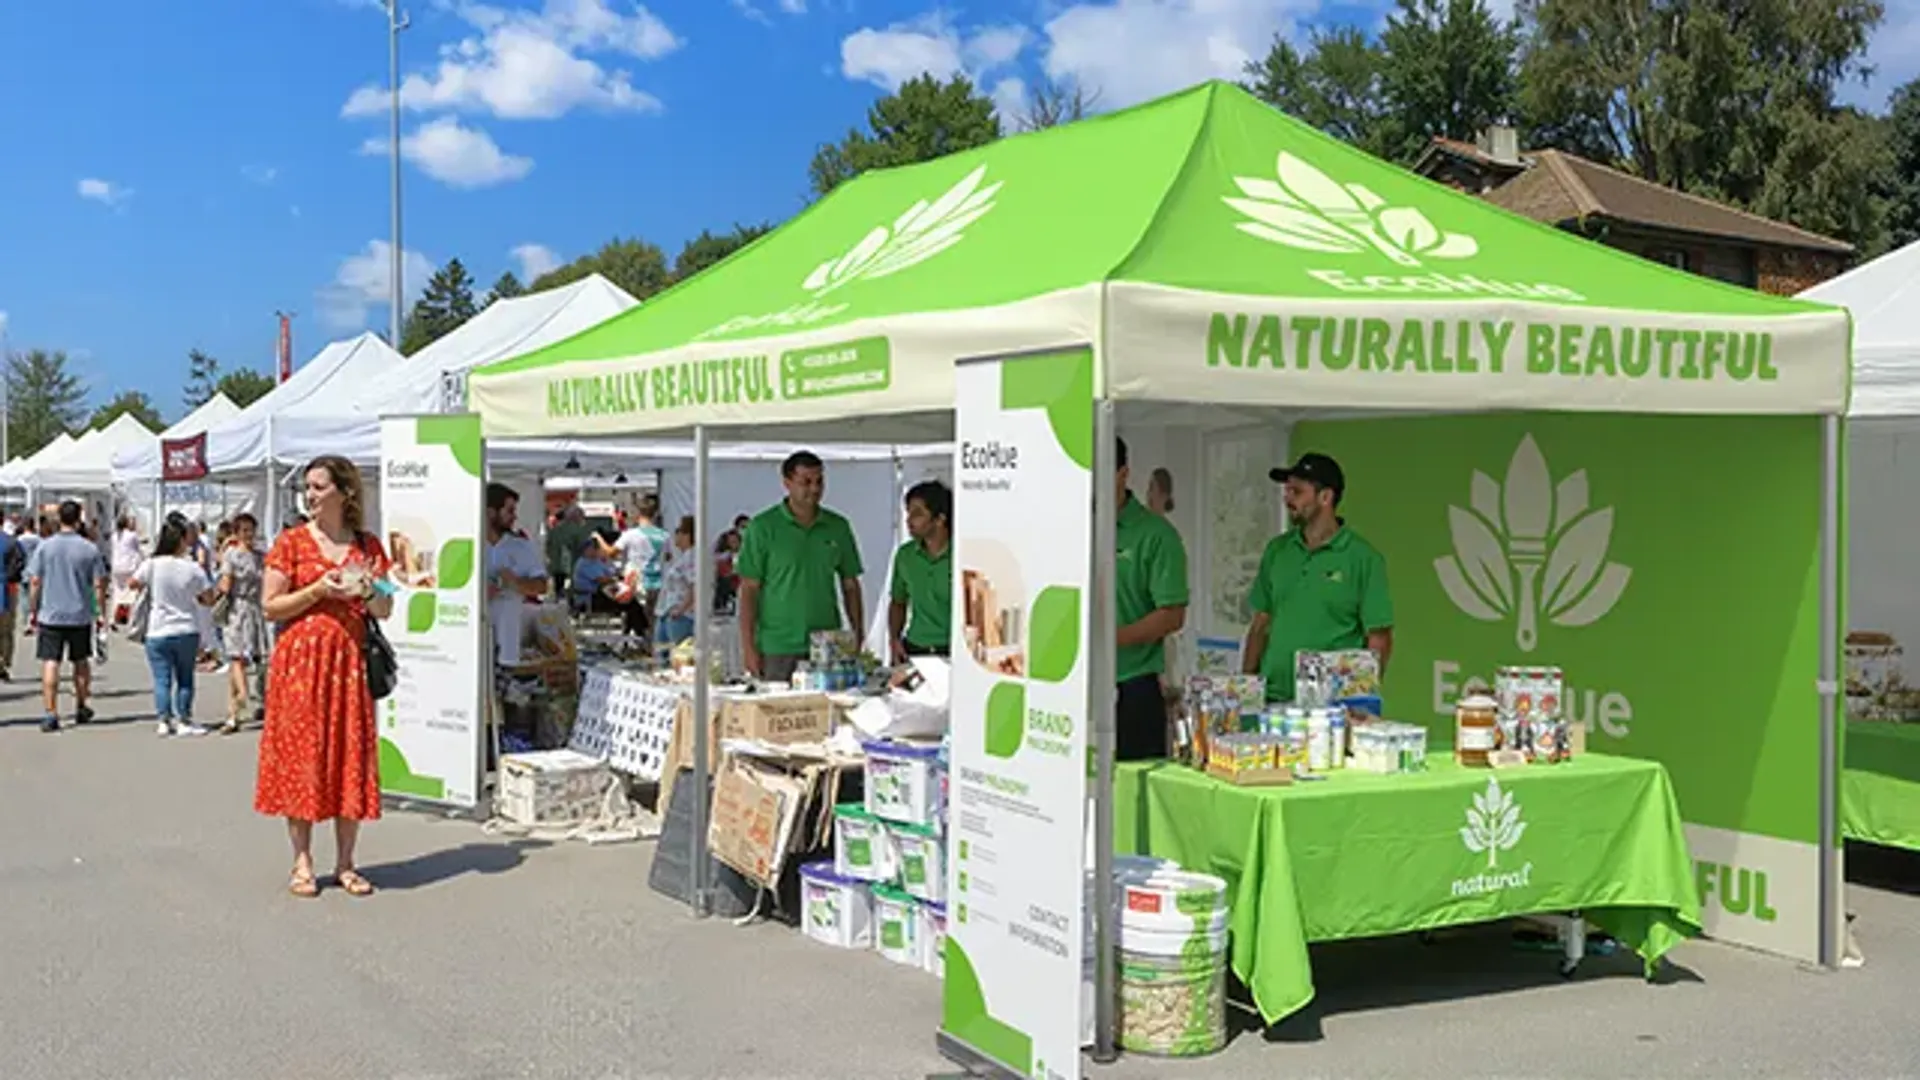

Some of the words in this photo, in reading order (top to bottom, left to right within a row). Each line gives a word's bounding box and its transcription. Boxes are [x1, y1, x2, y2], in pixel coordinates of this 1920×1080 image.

[1207, 313, 1513, 374] NATURALLY
[1526, 323, 1778, 381] BEAUTIFUL
[547, 370, 647, 417] NATURALLY
[652, 354, 774, 409] BEAUTIFUL
[962, 441, 1018, 469] EcoHue
[1452, 861, 1533, 896] natural
